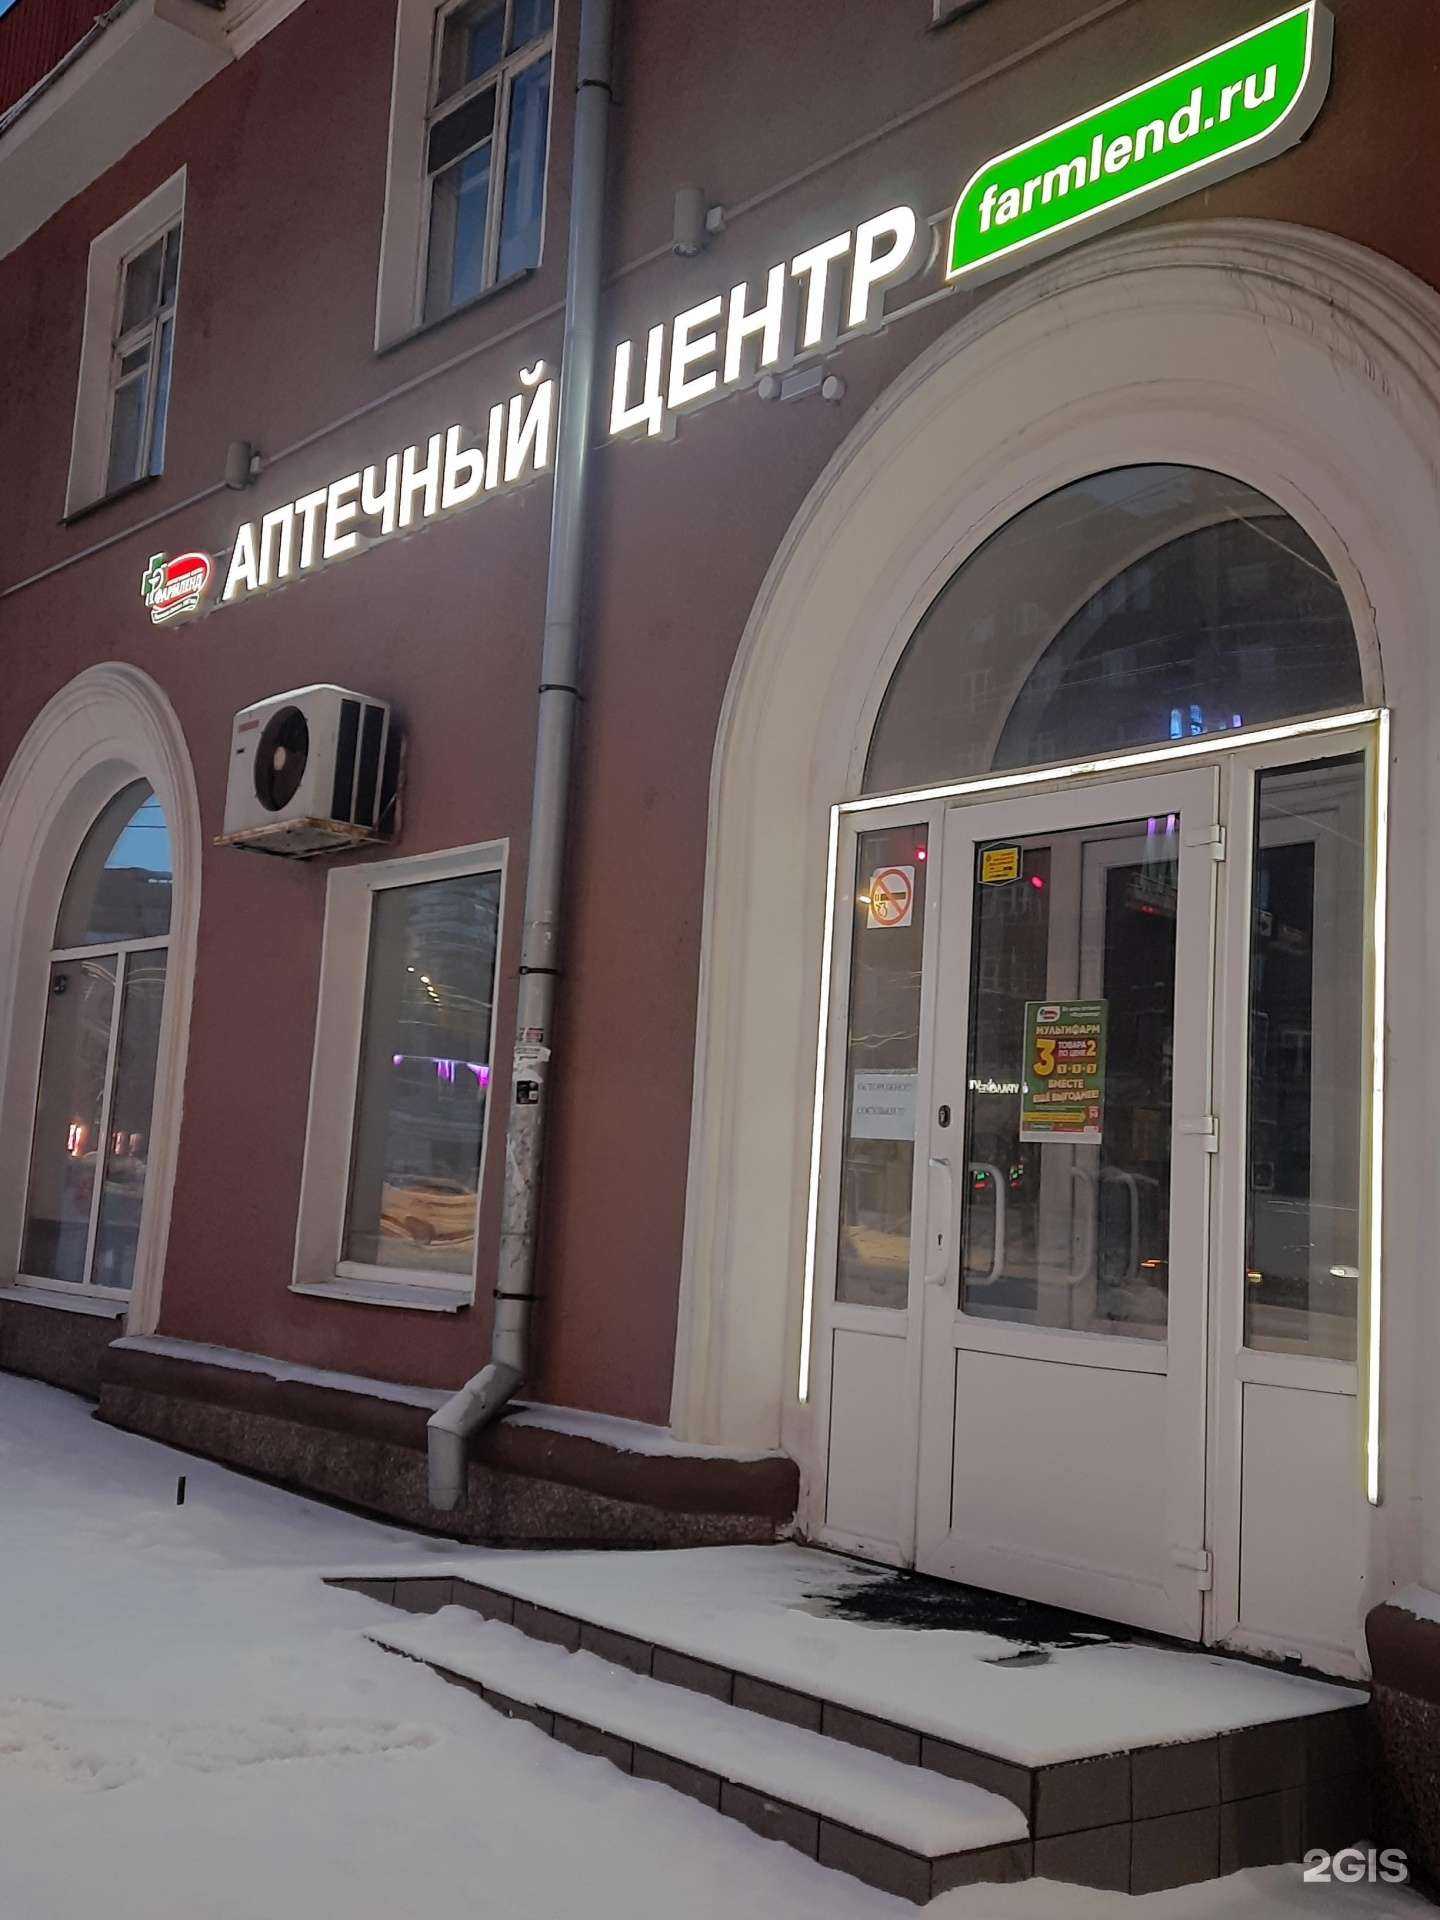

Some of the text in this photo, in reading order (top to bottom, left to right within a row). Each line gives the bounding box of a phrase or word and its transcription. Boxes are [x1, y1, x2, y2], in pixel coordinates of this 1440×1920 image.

[978, 64, 1277, 233] farmlend.ru
[222, 205, 916, 601] АПТЕЧНЫЙ ЦЕНТР
[1033, 1038, 1057, 1076] 3
[1087, 1040, 1097, 1057] 2
